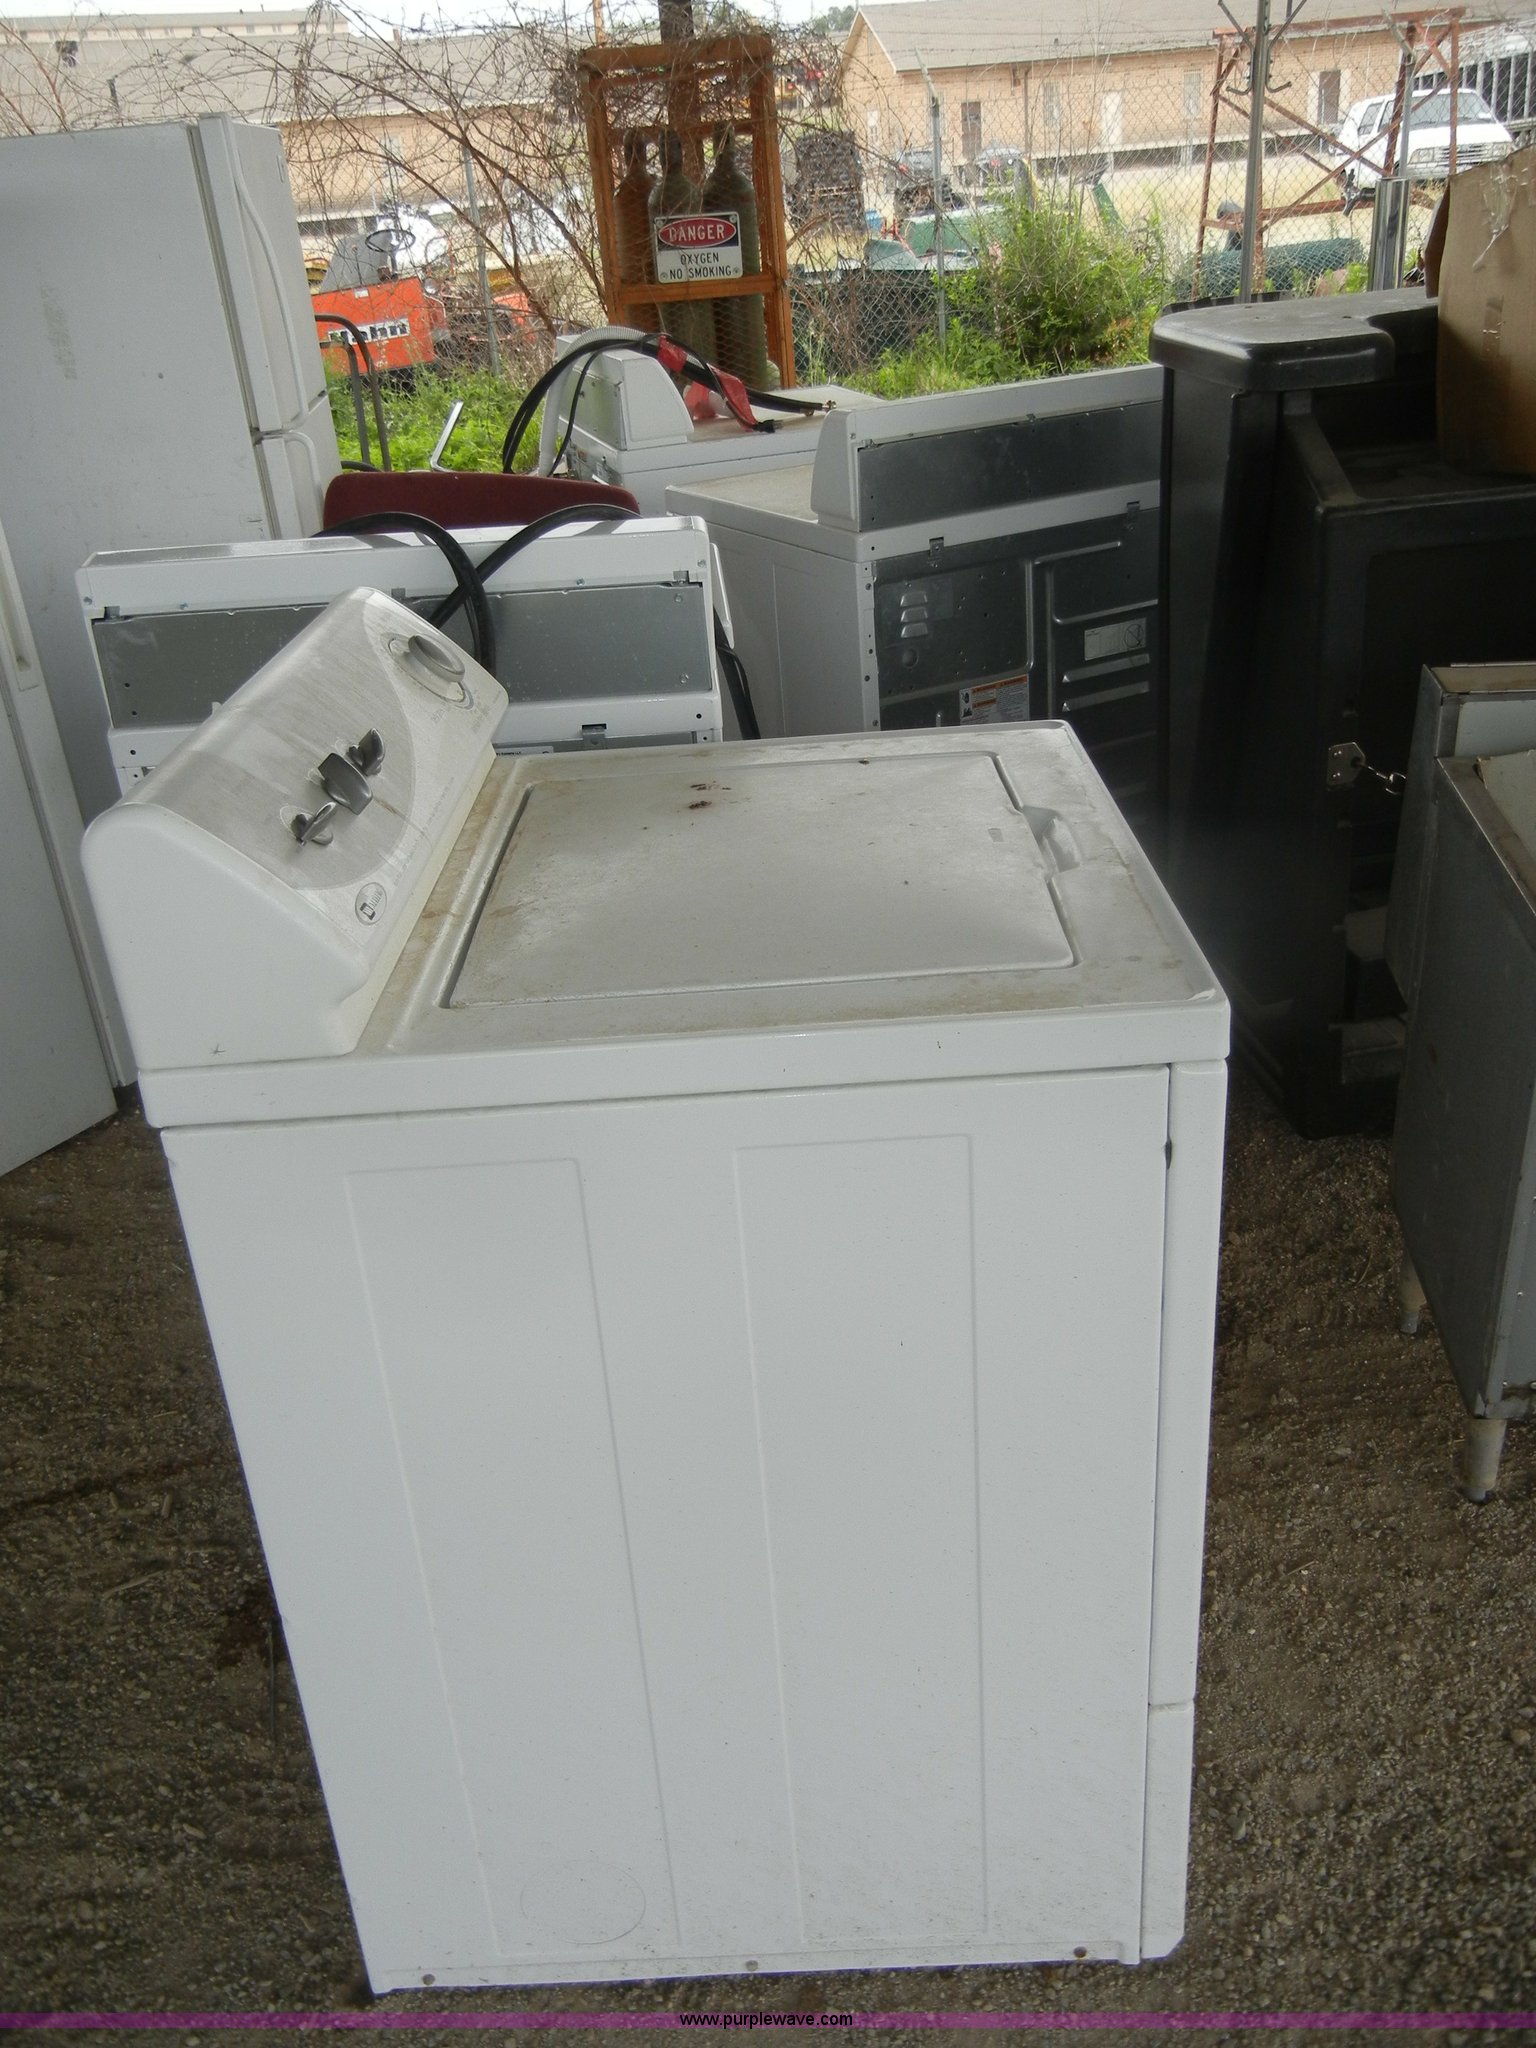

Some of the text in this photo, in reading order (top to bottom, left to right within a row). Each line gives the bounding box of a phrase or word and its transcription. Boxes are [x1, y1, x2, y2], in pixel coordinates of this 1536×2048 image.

[668, 224, 726, 242] DANGER
[680, 252, 720, 266] OXYGEN
[669, 265, 732, 280] NO SMOKING
